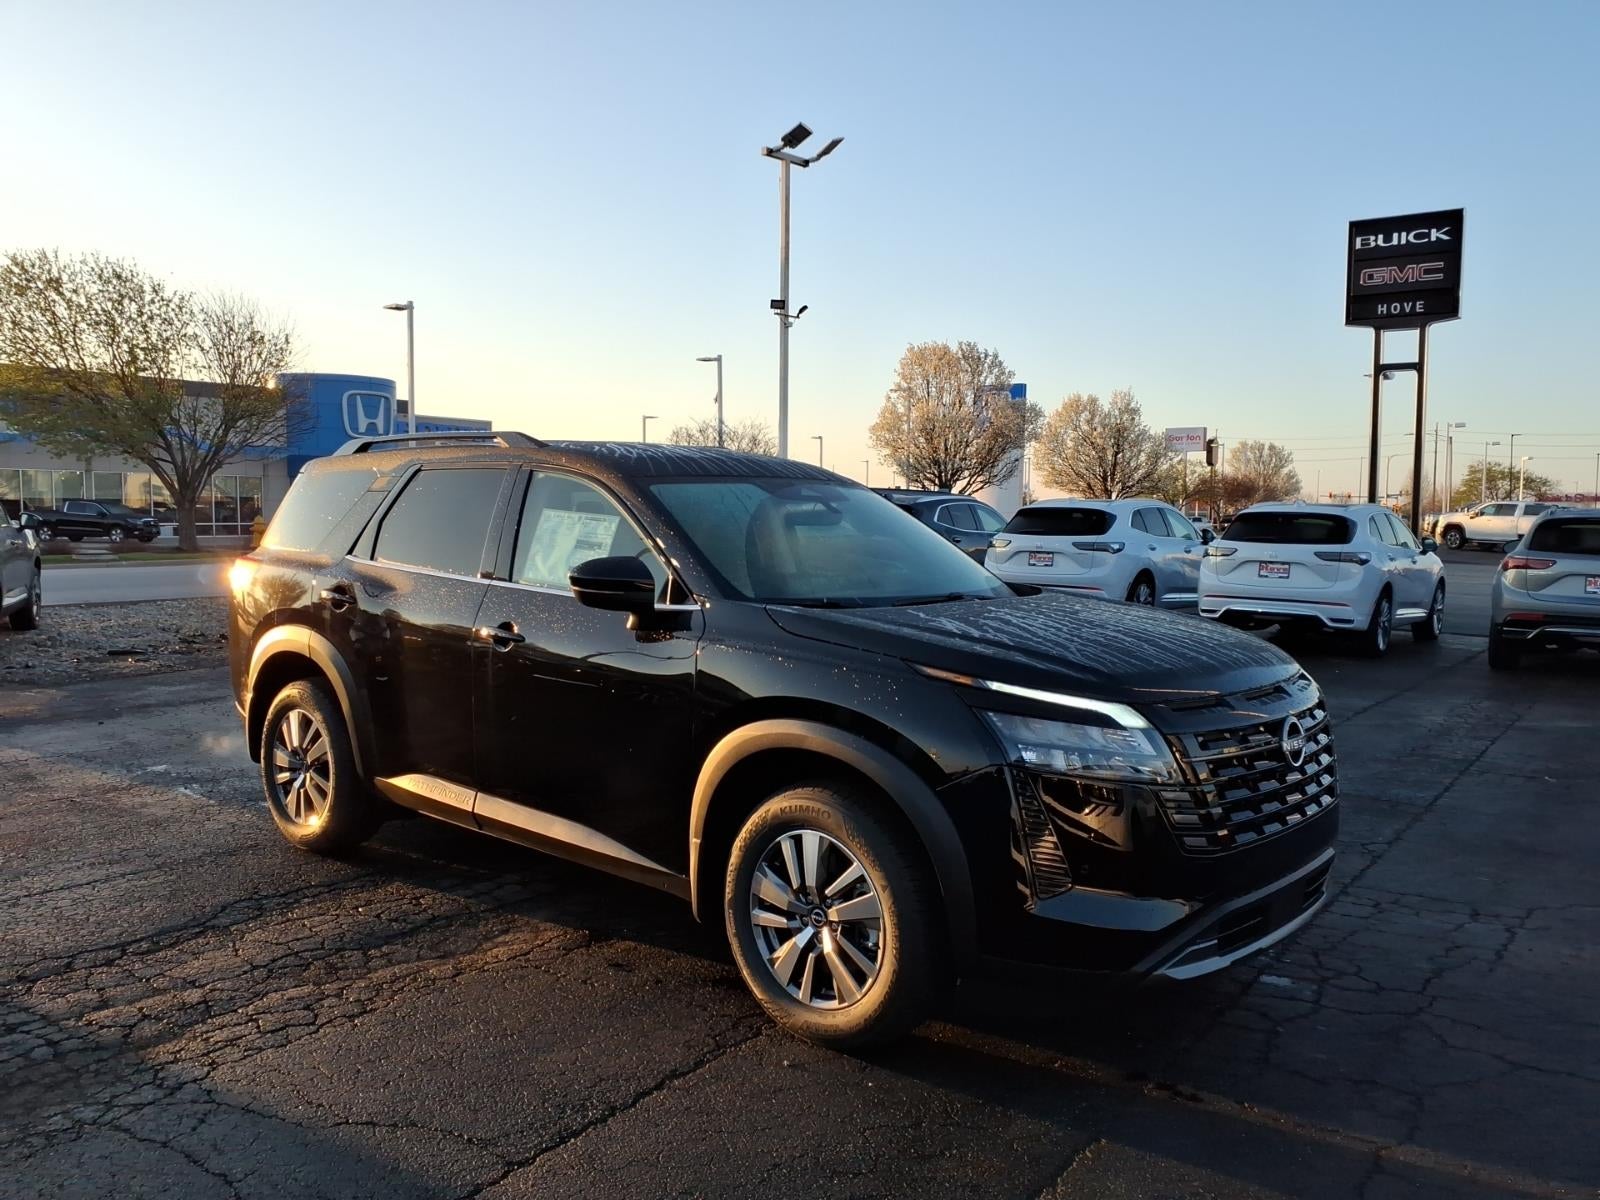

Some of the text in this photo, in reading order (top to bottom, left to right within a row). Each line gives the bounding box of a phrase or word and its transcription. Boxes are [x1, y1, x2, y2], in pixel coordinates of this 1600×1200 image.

[1355, 226, 1453, 250] BUICK
[1360, 262, 1445, 286] GMC
[1377, 301, 1426, 315] HOVE
[779, 804, 832, 821] KUMHO
